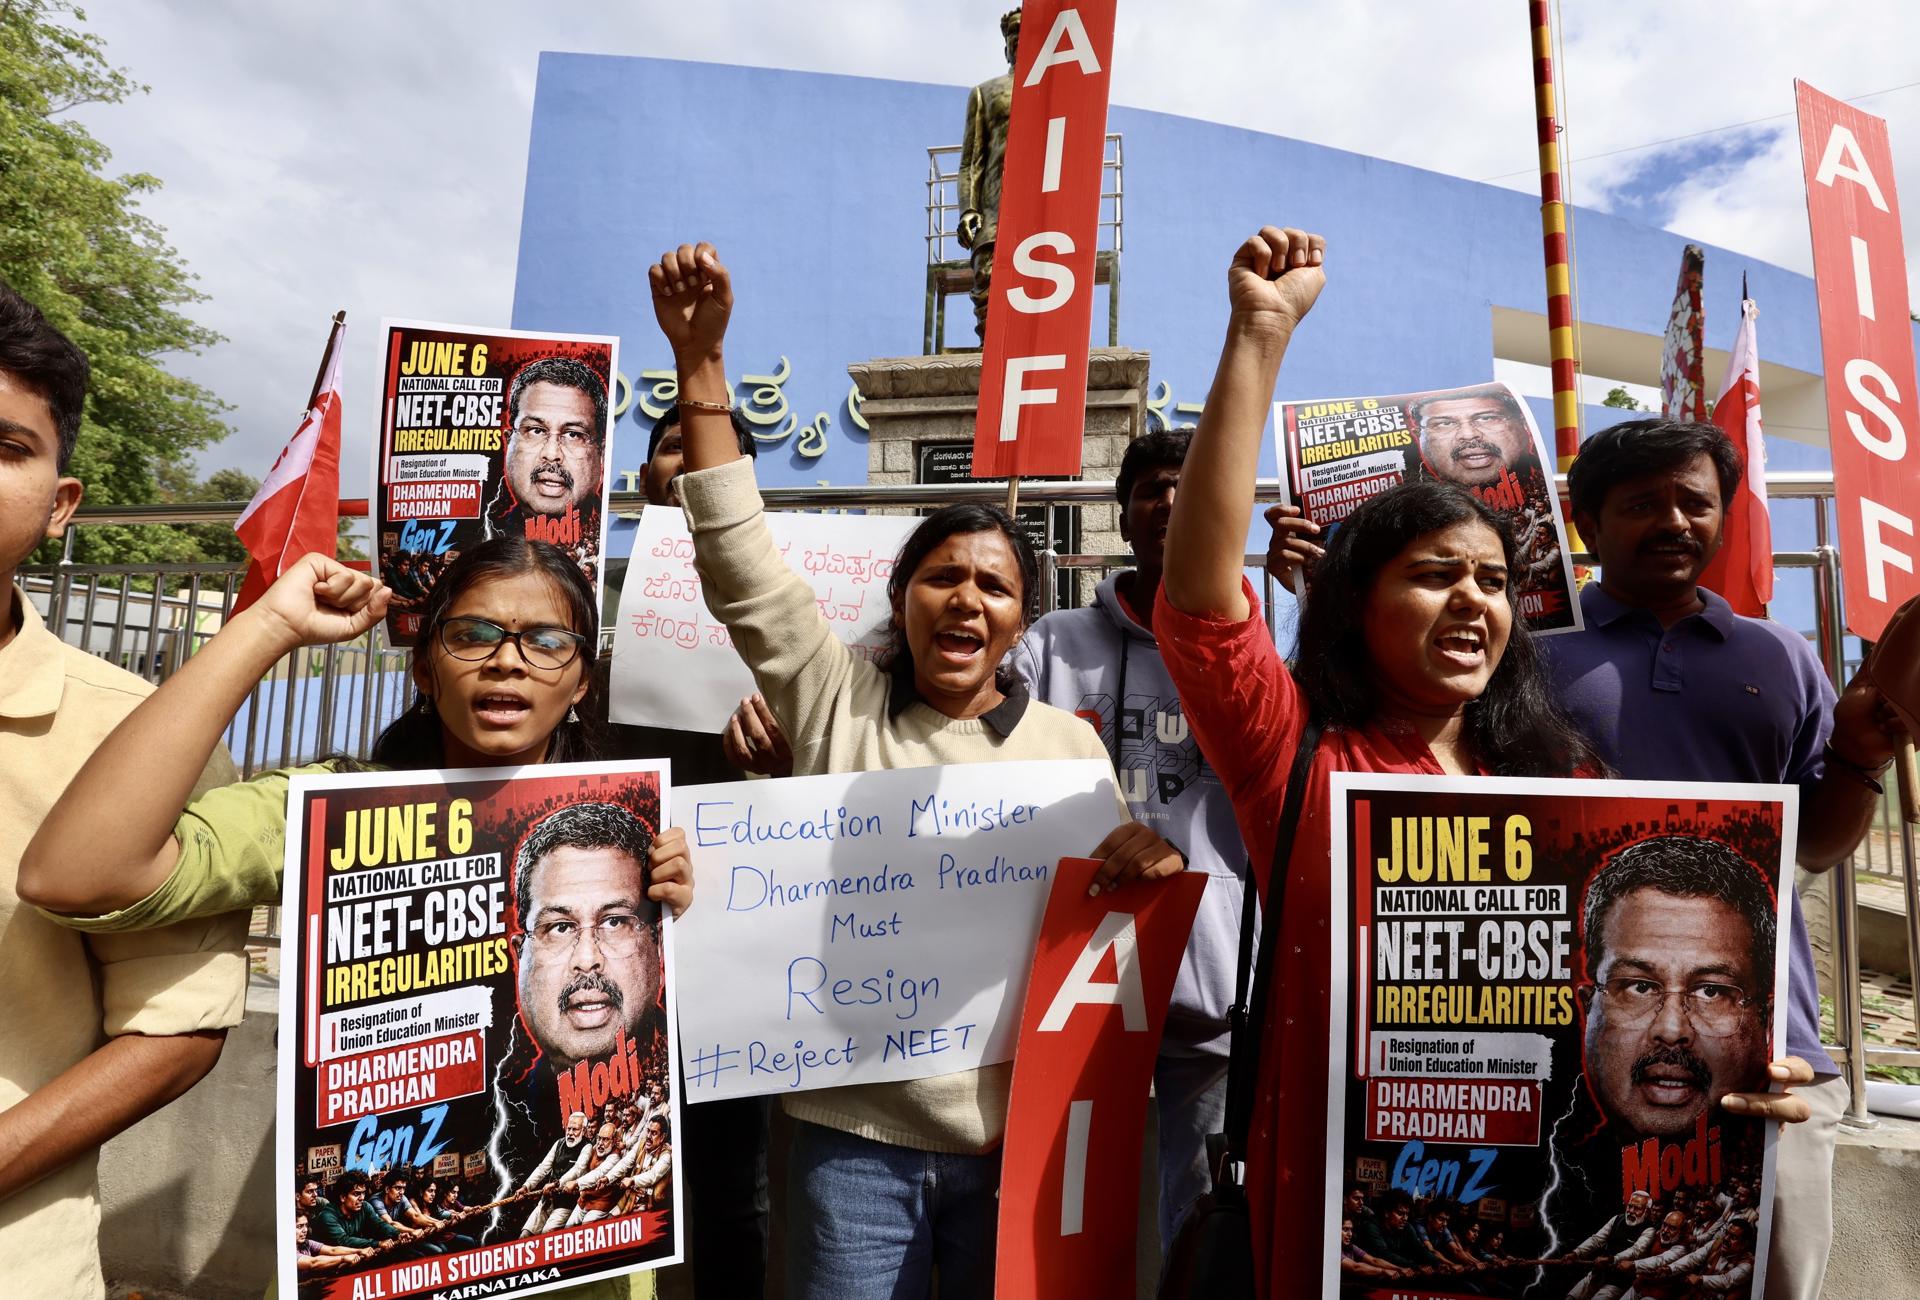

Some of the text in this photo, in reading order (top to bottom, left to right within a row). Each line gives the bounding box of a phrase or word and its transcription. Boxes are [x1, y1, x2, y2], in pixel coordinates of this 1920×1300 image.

[1000, 8, 1102, 442] AISF
[402, 341, 488, 377] JUNE 6
[1816, 124, 1914, 603] AISF
[401, 378, 499, 391] NATIONAL CALL FOR
[396, 395, 503, 428] NEET-CBSE
[1298, 399, 1379, 420] JUNE 6
[1300, 407, 1396, 427] NATIONAL CALL FOR
[394, 429, 502, 452] IRREGULARITIES
[1299, 413, 1407, 447] NEET-CBSE
[401, 458, 447, 470] Resignation of
[1301, 430, 1412, 465] IRREGULARITIES
[400, 468, 480, 479] Union Education Minister
[1312, 460, 1360, 478] Resignation of
[1312, 462, 1397, 487] Union Education Minister
[393, 484, 476, 501] DHARMENDRA
[1308, 475, 1398, 508] DHARMENDRA
[1471, 464, 1524, 512] odi
[392, 500, 451, 518] PRADHAN
[524, 500, 581, 544] Modi
[1310, 498, 1372, 523] PRADHA
[400, 518, 458, 556] Gen Z
[408, 616, 420, 632] AL
[330, 798, 474, 871] JUNE 6
[695, 794, 1041, 848] Education Minister
[1377, 814, 1532, 883] JUNE 6
[332, 857, 496, 899] NATIONAL CALL FOR
[726, 853, 1048, 911] Dharmendra Pradhan
[1380, 888, 1561, 913] NATIONAL CALL FOR
[327, 882, 505, 964] NEET-CBSE
[831, 912, 903, 943] Must
[1377, 920, 1571, 981] NEET-CBSE
[326, 937, 508, 1007] IRREGULARITIES
[786, 956, 940, 1020] Resign
[340, 1003, 423, 1032] Resignation of
[1376, 985, 1573, 1026] IRREGULARITIES
[340, 1012, 480, 1052] Union Education Minister
[1390, 1038, 1475, 1056] Resignation of
[328, 1037, 477, 1091] DHARMENDRA
[686, 1024, 977, 1088] #Reject NEET
[1389, 1057, 1538, 1075] Union Education Minister
[557, 1028, 643, 1130] Modi
[328, 1073, 436, 1120] PRADHAN
[1377, 1082, 1532, 1112] DHARMENDRA
[345, 1104, 455, 1175] Gen Z
[1376, 1110, 1486, 1139] PRADHAN
[311, 1156, 338, 1169] LEAKS
[315, 1148, 335, 1157] PAPER
[1622, 1111, 1722, 1204] Modi
[1358, 1168, 1384, 1180] LEAKS
[1391, 1140, 1500, 1205] Gen Z
[352, 1274, 386, 1300] ALL
[391, 1265, 442, 1292] INDIA
[544, 1217, 643, 1261] FEDERATION
[432, 1267, 561, 1300] KARNATAKA
